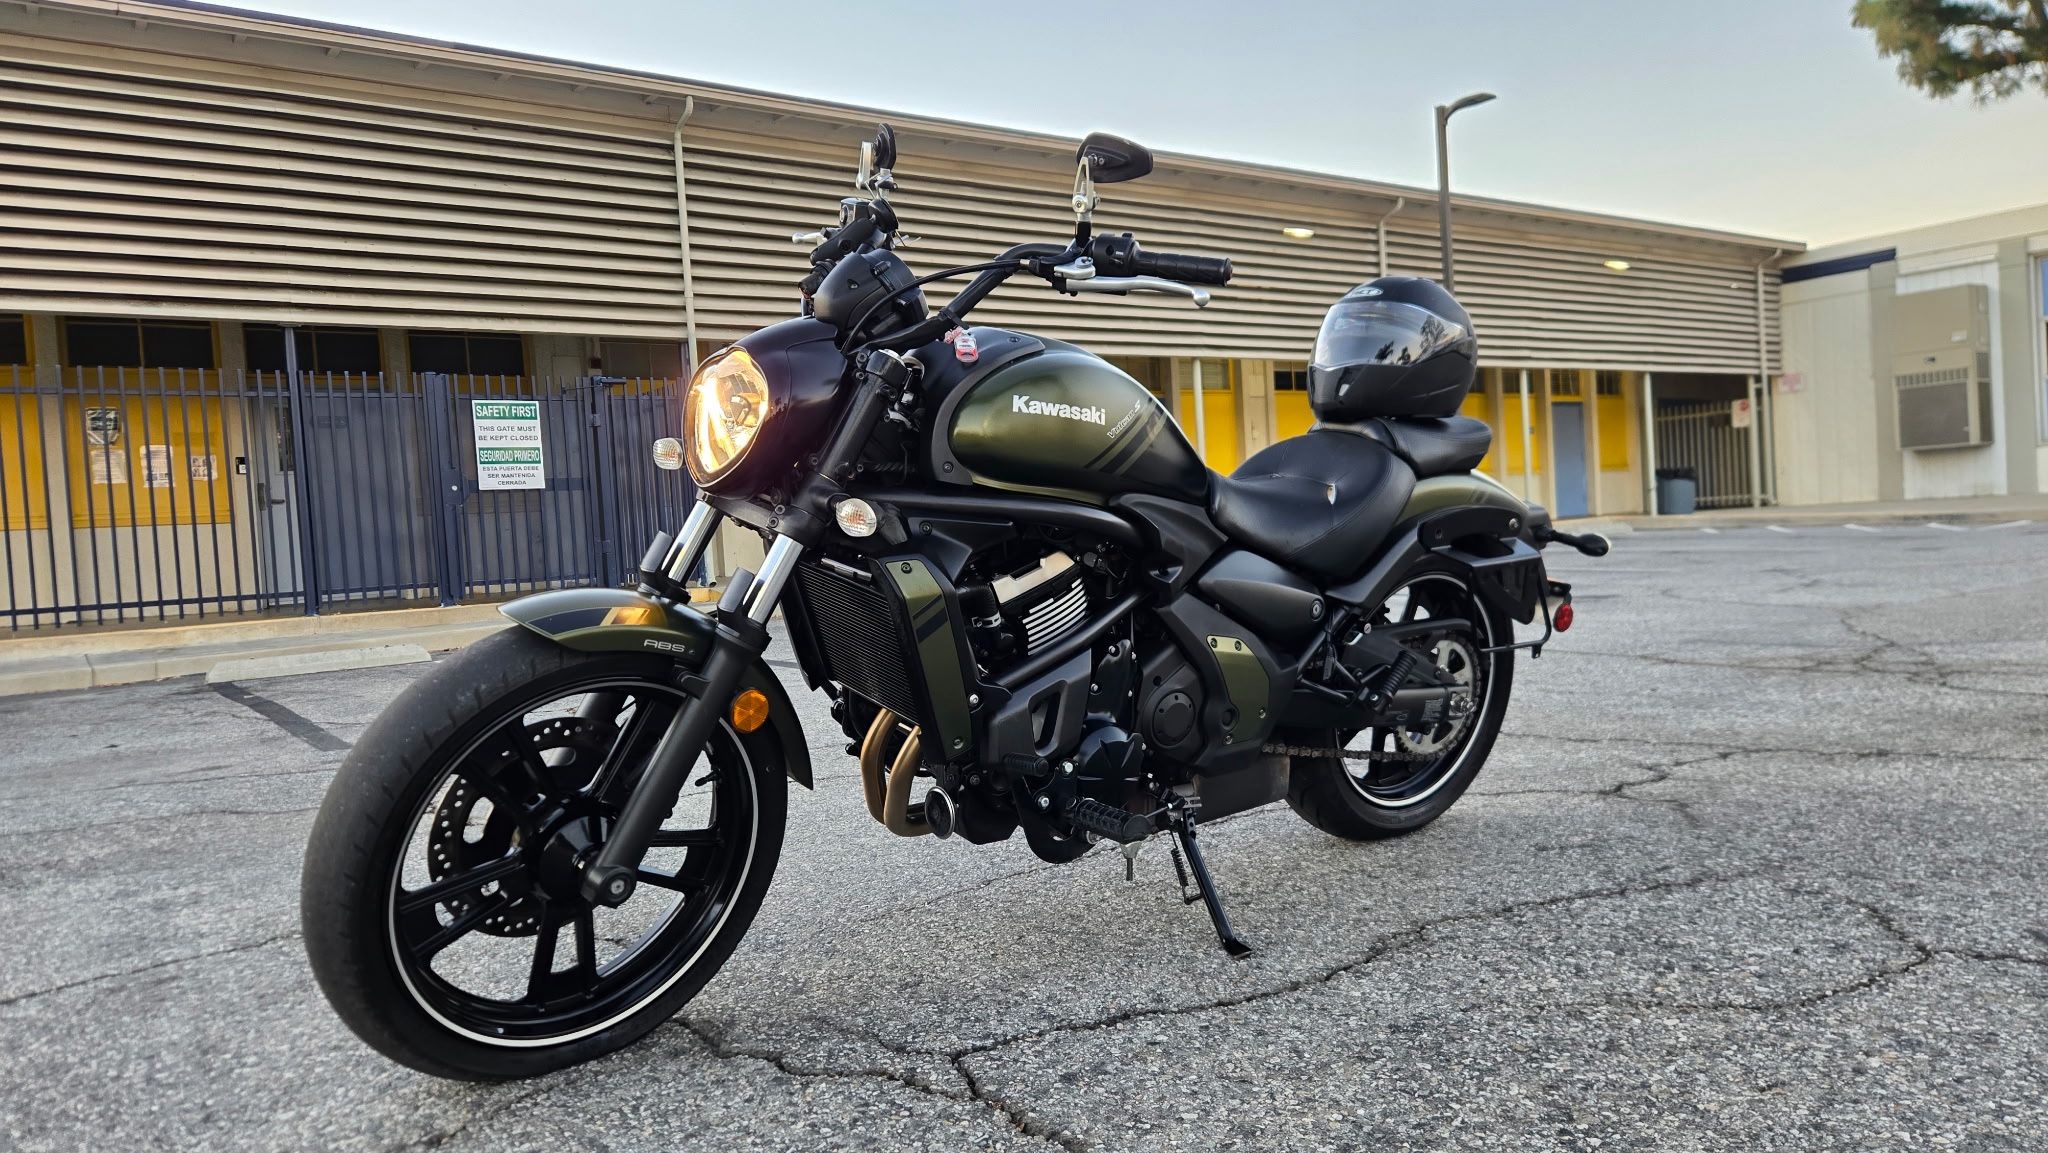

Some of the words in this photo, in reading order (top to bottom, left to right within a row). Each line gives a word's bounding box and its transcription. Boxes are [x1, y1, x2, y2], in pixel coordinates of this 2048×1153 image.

[475, 405, 510, 417] SAFETY
[511, 406, 536, 417] FIRST
[1012, 394, 1105, 425] Kawasaki
[480, 450, 514, 462] SEGURIDAD
[514, 450, 540, 462] PRIMERO
[643, 639, 686, 653] ABS
